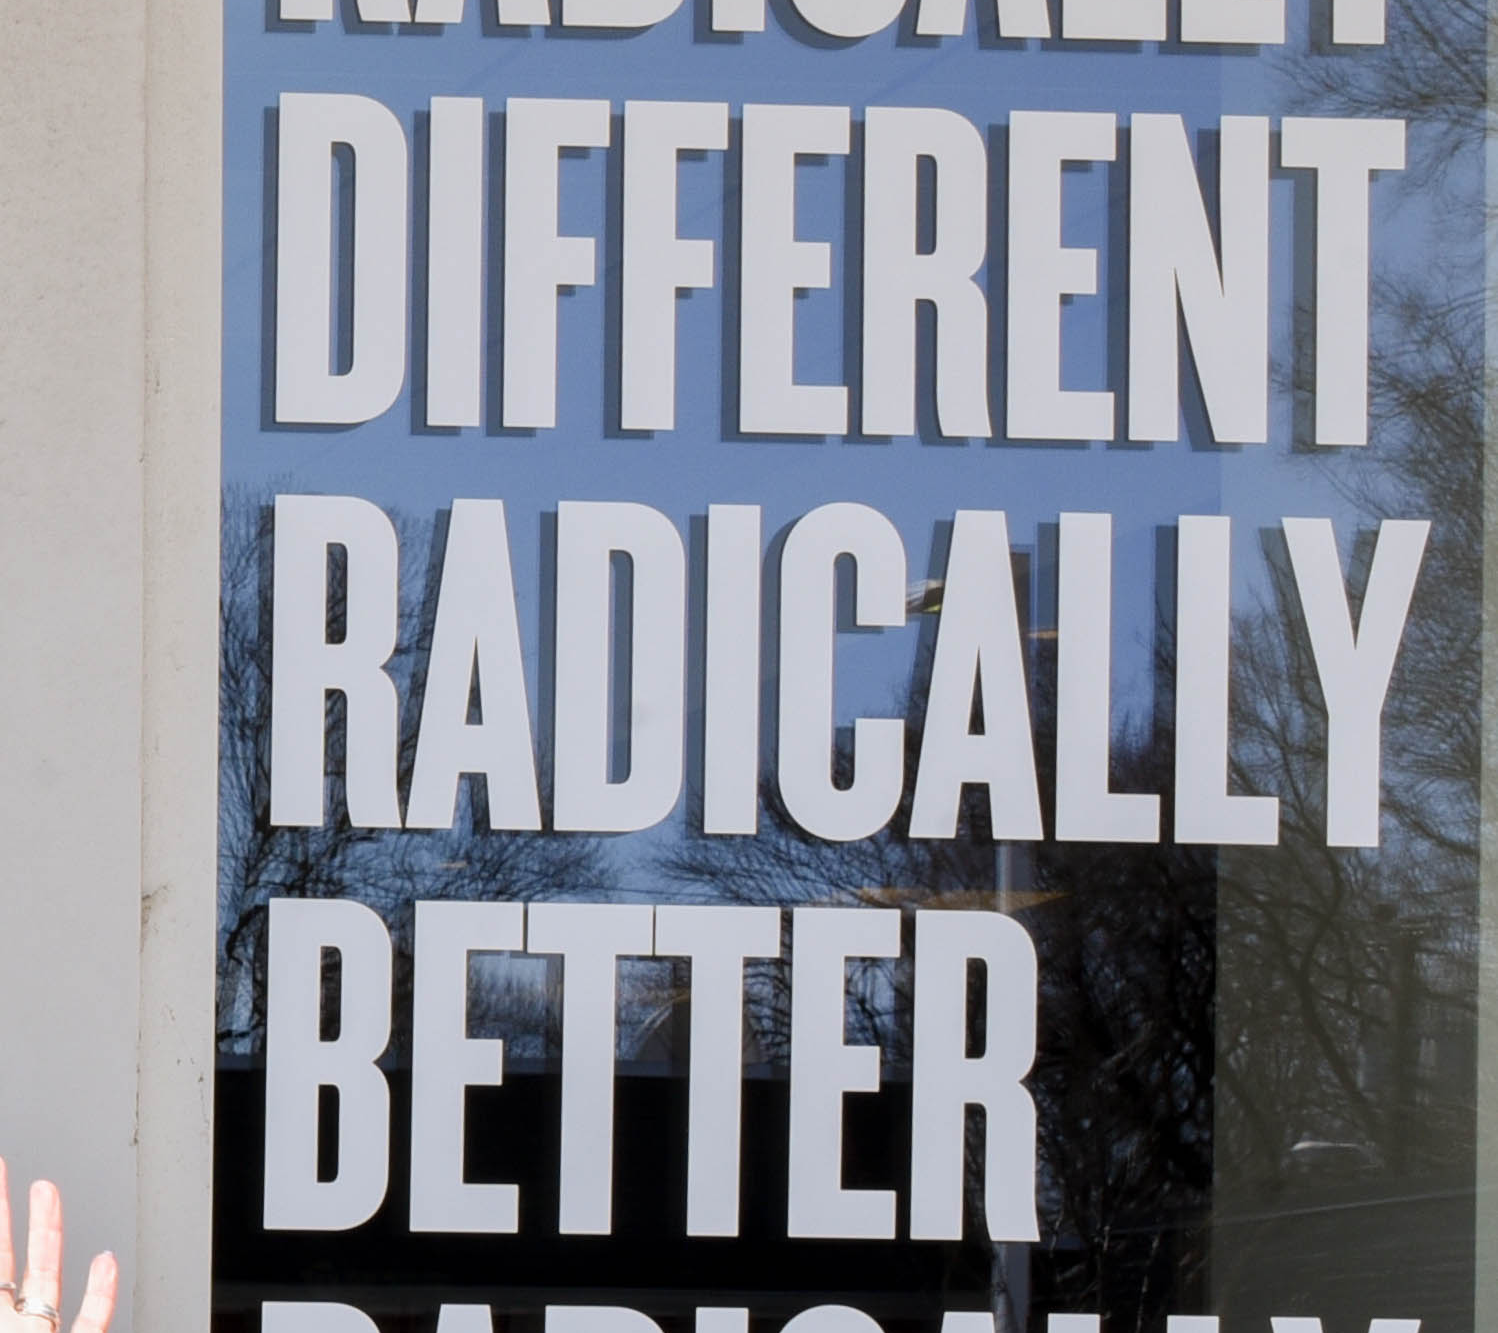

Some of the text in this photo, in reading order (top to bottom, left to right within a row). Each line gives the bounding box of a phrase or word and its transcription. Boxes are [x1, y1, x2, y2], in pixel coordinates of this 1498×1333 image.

[275, 92, 1407, 447] DIFFERENT
[268, 493, 1432, 848] RADICALLY
[262, 897, 1042, 1244] BETTER
